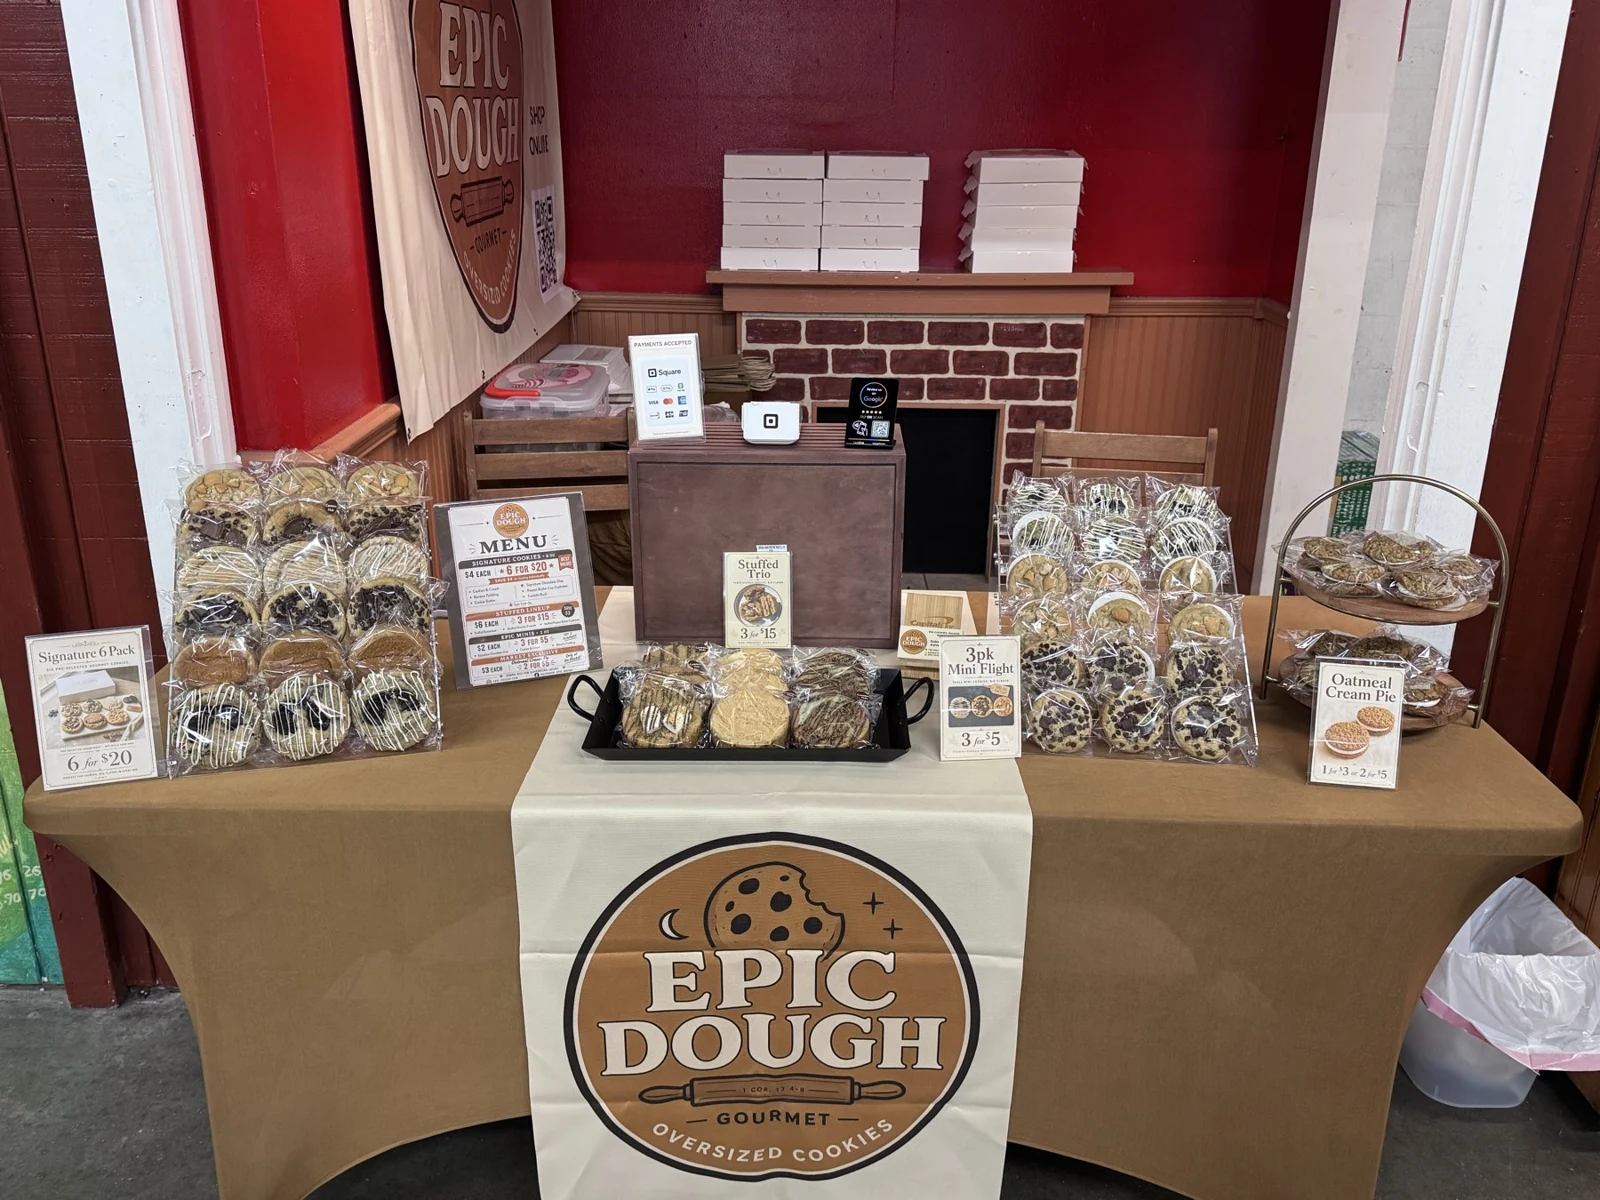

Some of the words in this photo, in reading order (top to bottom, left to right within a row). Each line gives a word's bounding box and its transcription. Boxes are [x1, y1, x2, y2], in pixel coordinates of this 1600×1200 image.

[439, 2, 509, 90] EPIC
[529, 105, 546, 126] SHOP
[425, 96, 519, 177] DOUGH
[528, 136, 549, 156] ONLINE
[475, 228, 502, 255] GOURMET
[463, 250, 502, 305] OVERSIZED
[499, 229, 518, 298] COOKIES
[663, 339, 692, 347] ACCEPTED
[658, 369, 682, 377] Square
[496, 517, 526, 526] DOUGH
[500, 512, 521, 520] EPIC
[479, 534, 548, 555] MENU
[471, 557, 510, 567] SIGNATURE
[512, 554, 542, 562] COOKIES
[738, 559, 779, 570] Stuffed
[465, 570, 475, 579] $4
[476, 569, 491, 578] EACH
[506, 565, 513, 575] 6
[515, 565, 529, 574] FOR
[531, 561, 547, 571] $20
[746, 569, 771, 579] Trio
[495, 608, 525, 617] STUFFED
[526, 605, 551, 613] LINEUP
[474, 621, 483, 629] $6
[484, 620, 499, 628] EACH
[517, 616, 523, 624] 3
[524, 615, 536, 623] FOR
[537, 613, 550, 621] $15
[740, 627, 748, 639] 3
[749, 631, 760, 639] for
[760, 627, 777, 639] $15
[477, 643, 485, 652] $2
[487, 643, 501, 651] EACH
[520, 638, 526, 647] 3
[527, 637, 539, 645] FOR
[540, 635, 549, 644] $5
[902, 639, 925, 647] DOUGH
[38, 649, 97, 665] Signature
[98, 646, 107, 658] 6
[109, 644, 136, 657] Pack
[500, 653, 526, 661] MARKET
[527, 649, 559, 658] EXCLUSIVE
[965, 647, 994, 664] 3pk
[55, 664, 88, 672] PRE-SELECTED
[481, 666, 490, 674] $3
[530, 661, 541, 669] FOR
[541, 660, 550, 668] $5
[948, 663, 976, 676] Mini
[980, 662, 1015, 677] Flight
[1331, 673, 1392, 690] Oatmeal
[1325, 686, 1371, 700] Cream
[1376, 689, 1397, 703] Pie
[961, 732, 971, 747] 3
[973, 736, 985, 747] for
[985, 731, 1001, 746] $5
[67, 755, 79, 772] 6
[82, 755, 99, 771] for
[101, 749, 132, 767] $20
[1322, 764, 1327, 774] 1
[1339, 766, 1349, 776] $3
[1360, 768, 1367, 778] 2
[1378, 769, 1387, 779] $5
[643, 948, 898, 1013] EPIC
[597, 1012, 948, 1077] DOUGH
[716, 1109, 831, 1126] GOURMET
[652, 1122, 783, 1163] OVERSIZED
[792, 1118, 894, 1163] COOKIES
